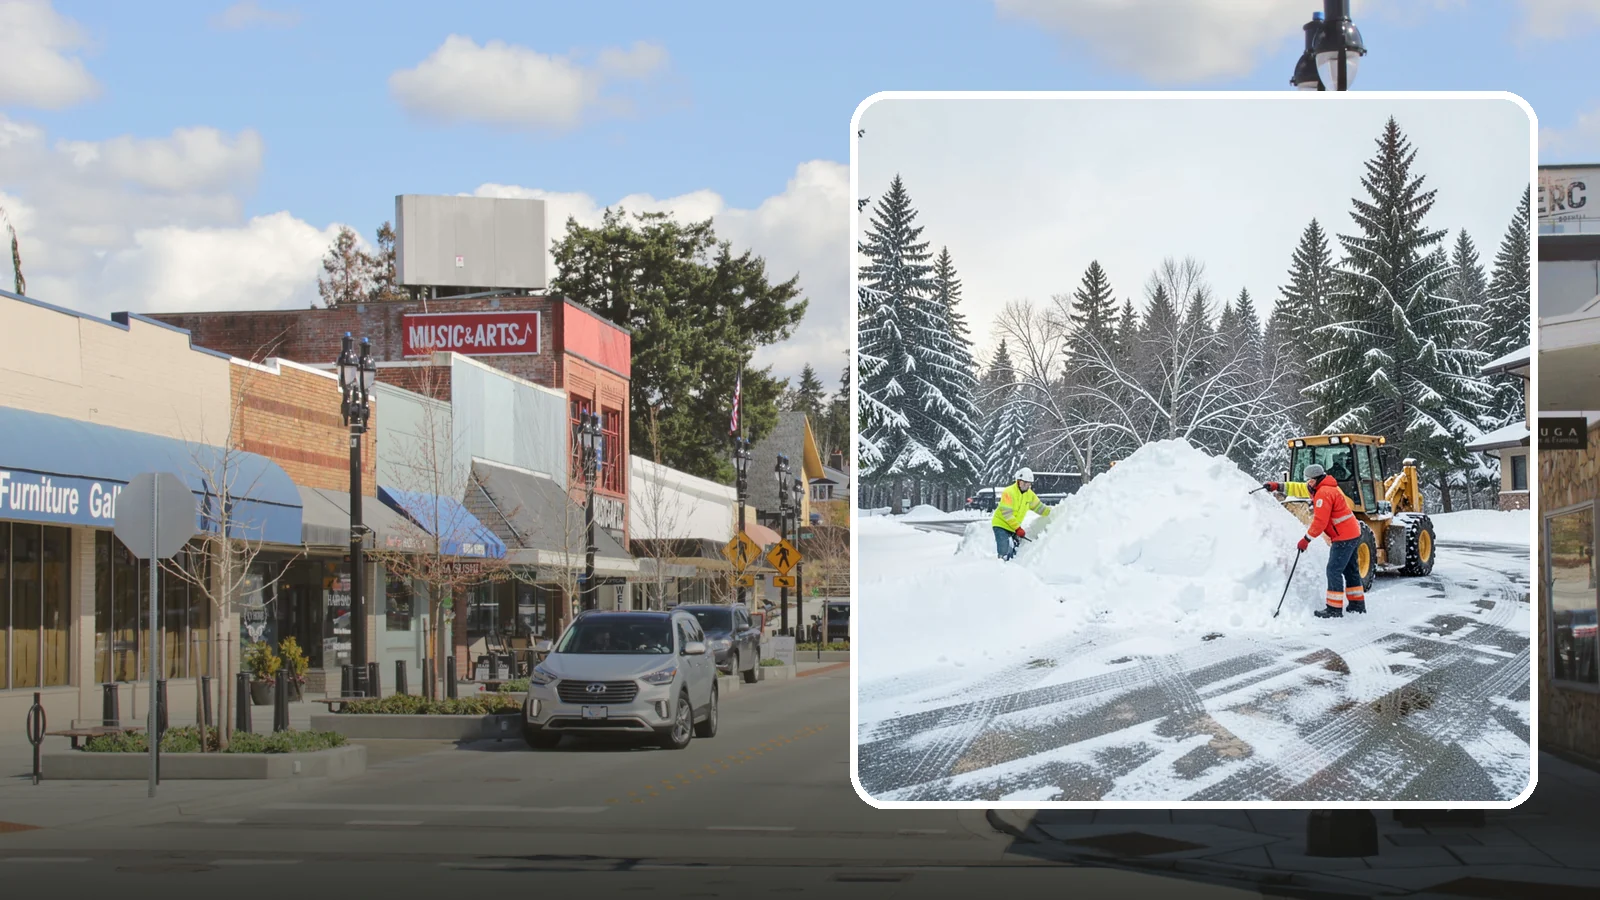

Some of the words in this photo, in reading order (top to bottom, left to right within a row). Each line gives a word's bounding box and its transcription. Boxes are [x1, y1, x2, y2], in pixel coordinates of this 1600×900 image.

[409, 323, 520, 348] MUSIC&ARTS
[0, 471, 80, 515] Furniture
[89, 482, 122, 519] Gal
[453, 563, 479, 573] SUSHI
